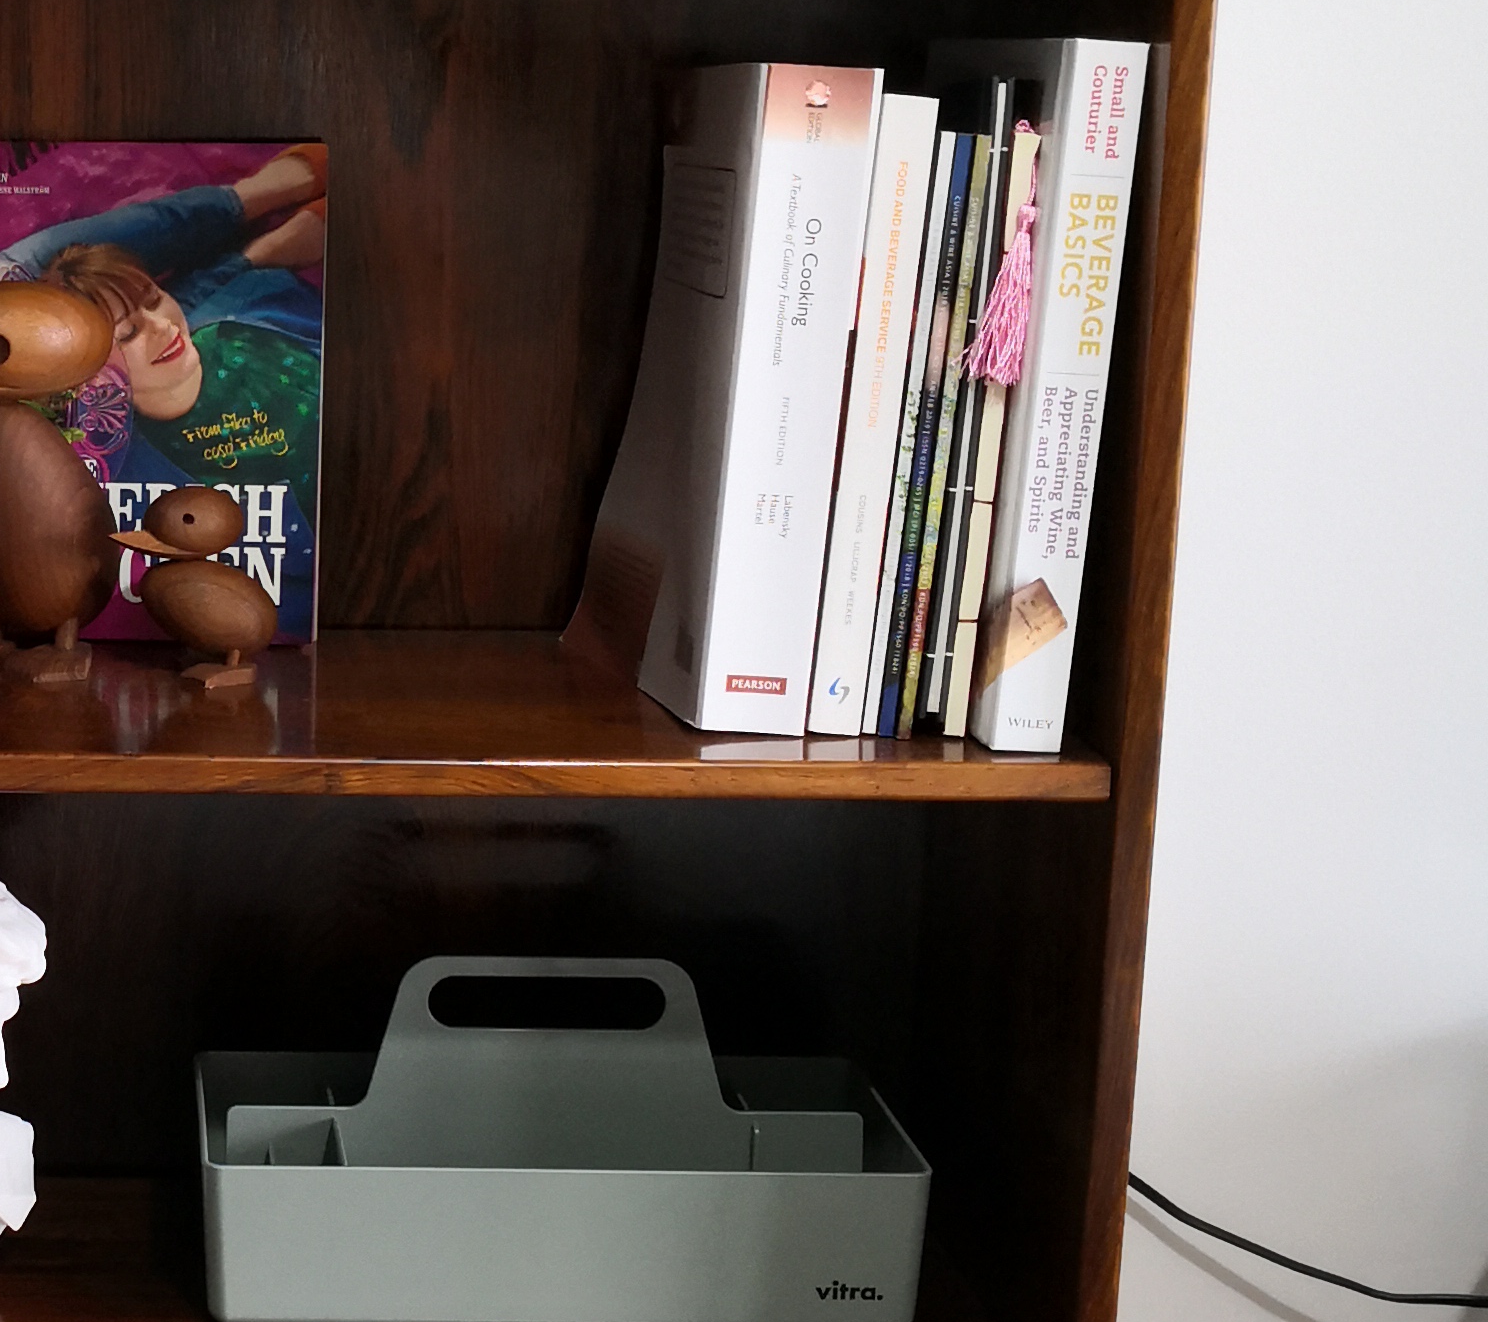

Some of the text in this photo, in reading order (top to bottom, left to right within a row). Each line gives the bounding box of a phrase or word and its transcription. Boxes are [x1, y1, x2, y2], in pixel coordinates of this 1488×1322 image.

[1085, 65, 1108, 153] Couturier
[1104, 66, 1129, 159] Small and
[895, 161, 908, 197] FOOD
[787, 184, 802, 230] Textbook
[891, 200, 904, 226] AND
[783, 233, 796, 247] of
[883, 229, 901, 297] BEVERAGE
[1058, 192, 1092, 299] BASICS
[777, 248, 794, 291] Culinary
[791, 218, 822, 327] On Cooking
[944, 260, 954, 278] ASIA
[1078, 194, 1119, 356] BEVERAGE
[772, 293, 790, 367] Fundamentals
[876, 300, 892, 353] SERVICE
[253, 409, 268, 423] to
[867, 381, 882, 428] EDITION
[776, 425, 787, 466] EDITION
[1028, 386, 1058, 533] Beer, and Spirits
[1041, 387, 1078, 559] Appreciating Wine,
[1065, 388, 1099, 559] Understanding and
[778, 495, 794, 539] Labensky
[855, 494, 866, 534] COUSINS
[731, 678, 781, 691] PEARSON
[1008, 717, 1054, 729] WILEY
[815, 1280, 884, 1301] vitra.
